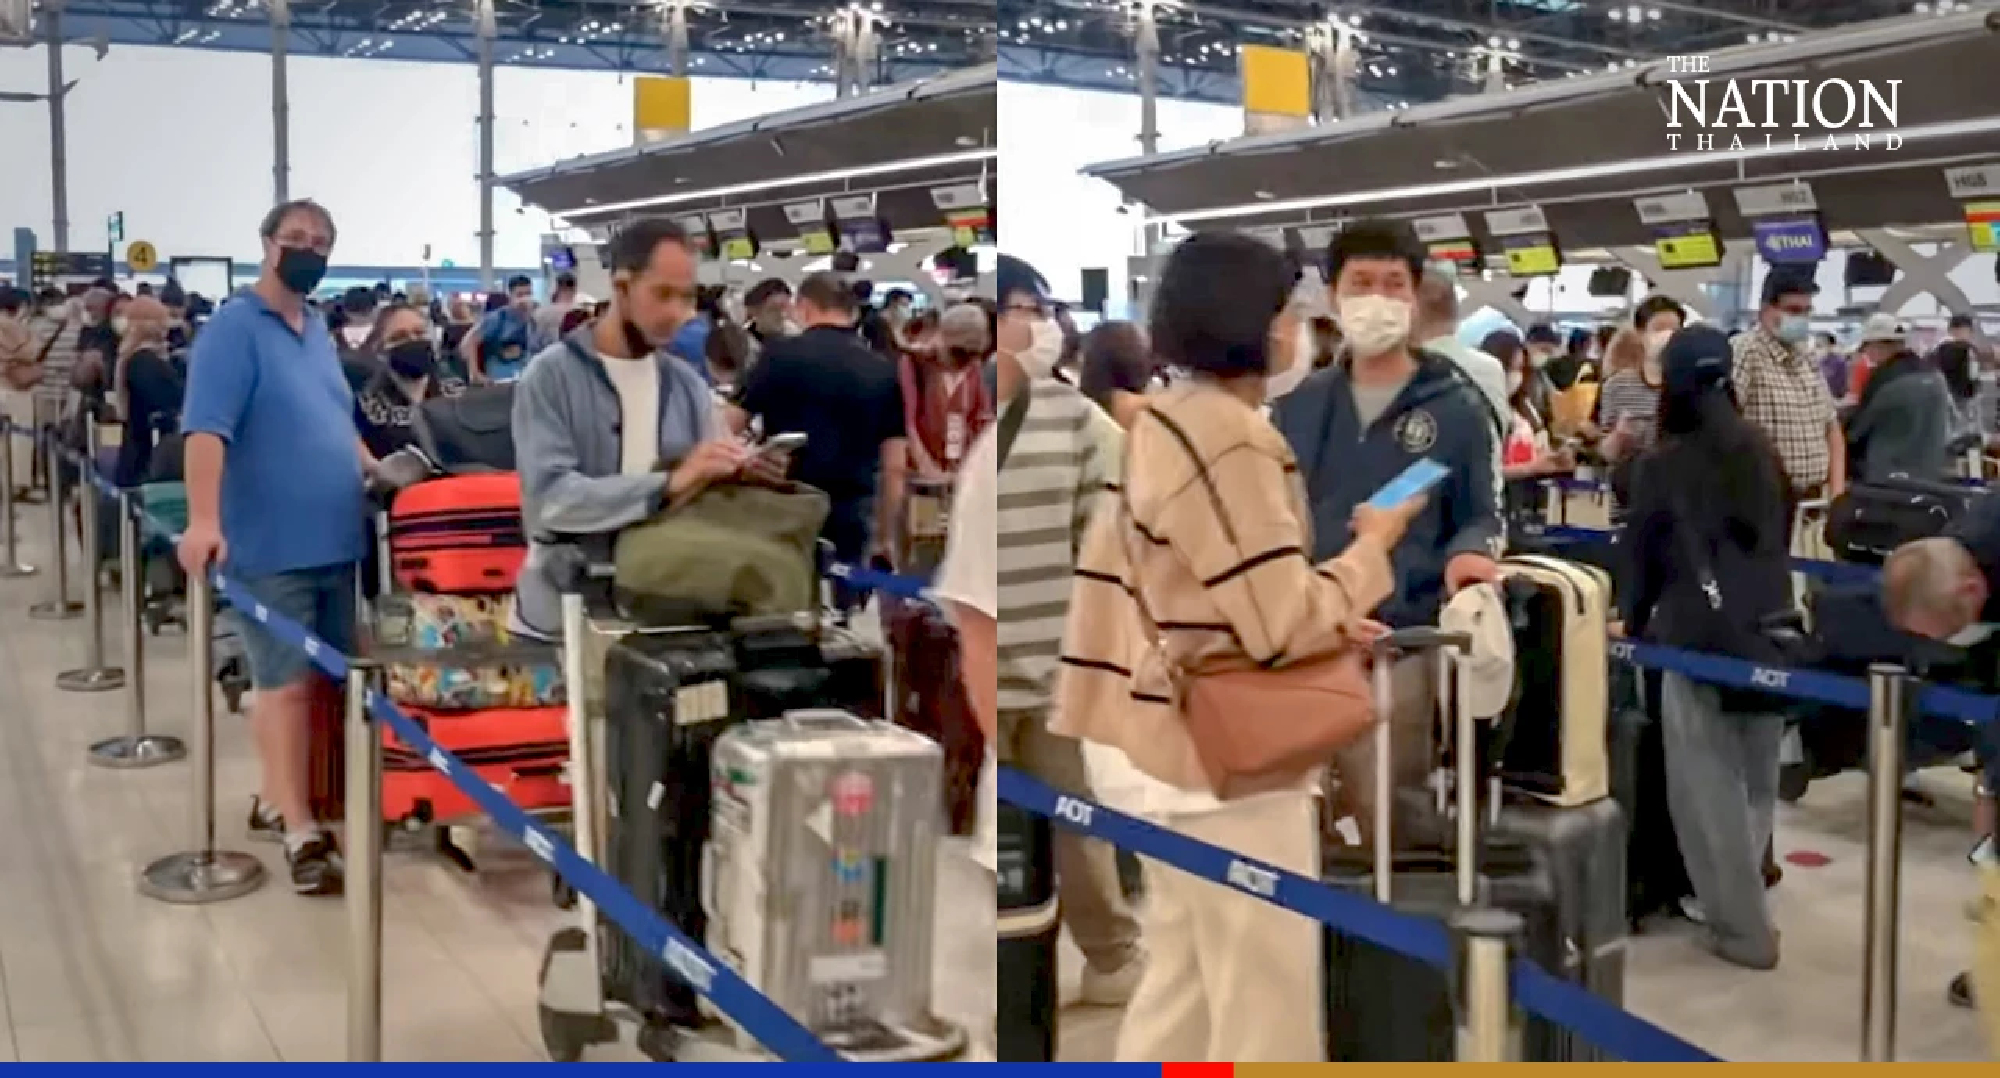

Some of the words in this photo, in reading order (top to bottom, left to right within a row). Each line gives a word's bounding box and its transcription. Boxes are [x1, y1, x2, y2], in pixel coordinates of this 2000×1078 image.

[134, 246, 149, 266] 4
[1610, 643, 1637, 661] OT
[1751, 666, 1791, 688] AOT
[1055, 796, 1095, 826] AOT
